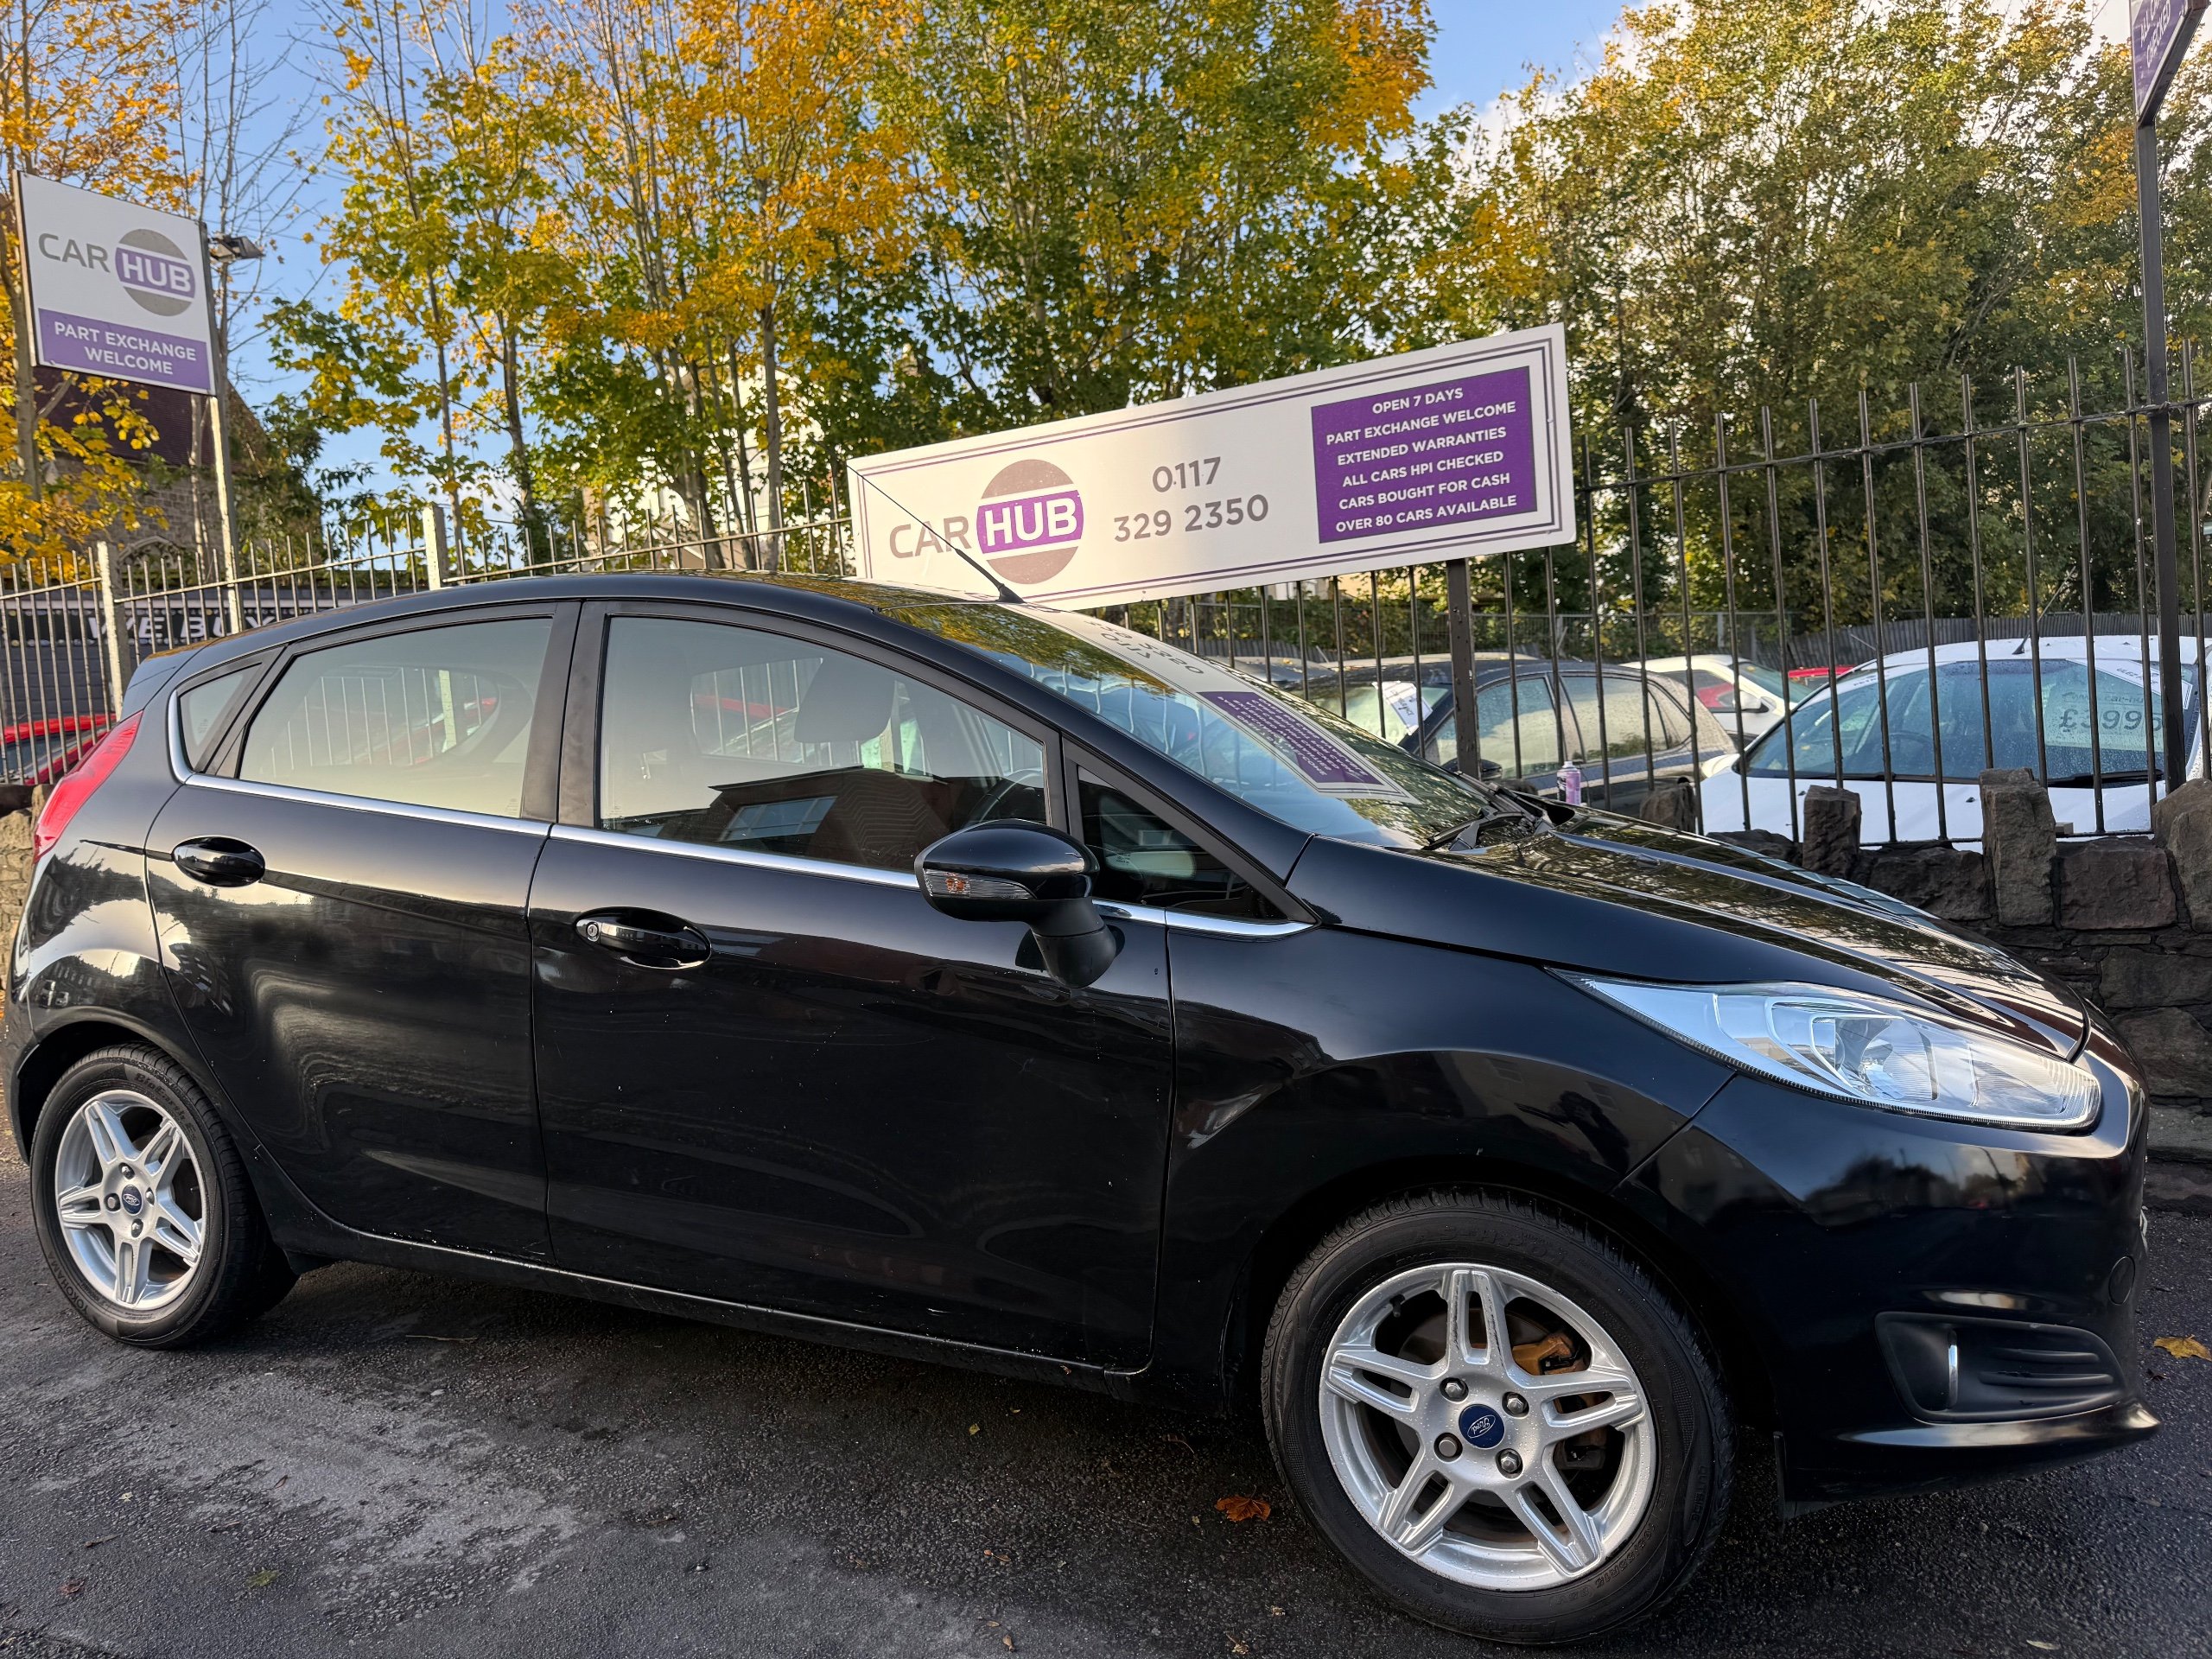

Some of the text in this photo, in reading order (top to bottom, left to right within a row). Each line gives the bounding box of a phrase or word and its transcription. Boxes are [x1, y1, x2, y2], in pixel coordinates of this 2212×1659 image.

[38, 232, 191, 292] CAR HUB
[54, 321, 196, 361] PART EXCHANGE
[84, 346, 173, 375] WELCOME
[1372, 387, 1464, 414] OPEN 7 DAYS
[1326, 401, 1516, 445] PART EXCHANGE WELCOME
[1338, 427, 1507, 466] EXTENDED WARRANTIES
[1152, 456, 1221, 493] 0117
[1343, 451, 1503, 487] ALL CARS HPI CHECKED
[1338, 473, 1510, 510] CARS BOUGHT FOR CASH
[890, 498, 1077, 559] CAR HUB
[1115, 494, 1268, 543] 329 2350
[1336, 495, 1517, 532] OVER 80 CARS AVAILABLE
[48, 1251, 89, 1312] YOKOHAMA
[1471, 1417, 1491, 1434] Ford
